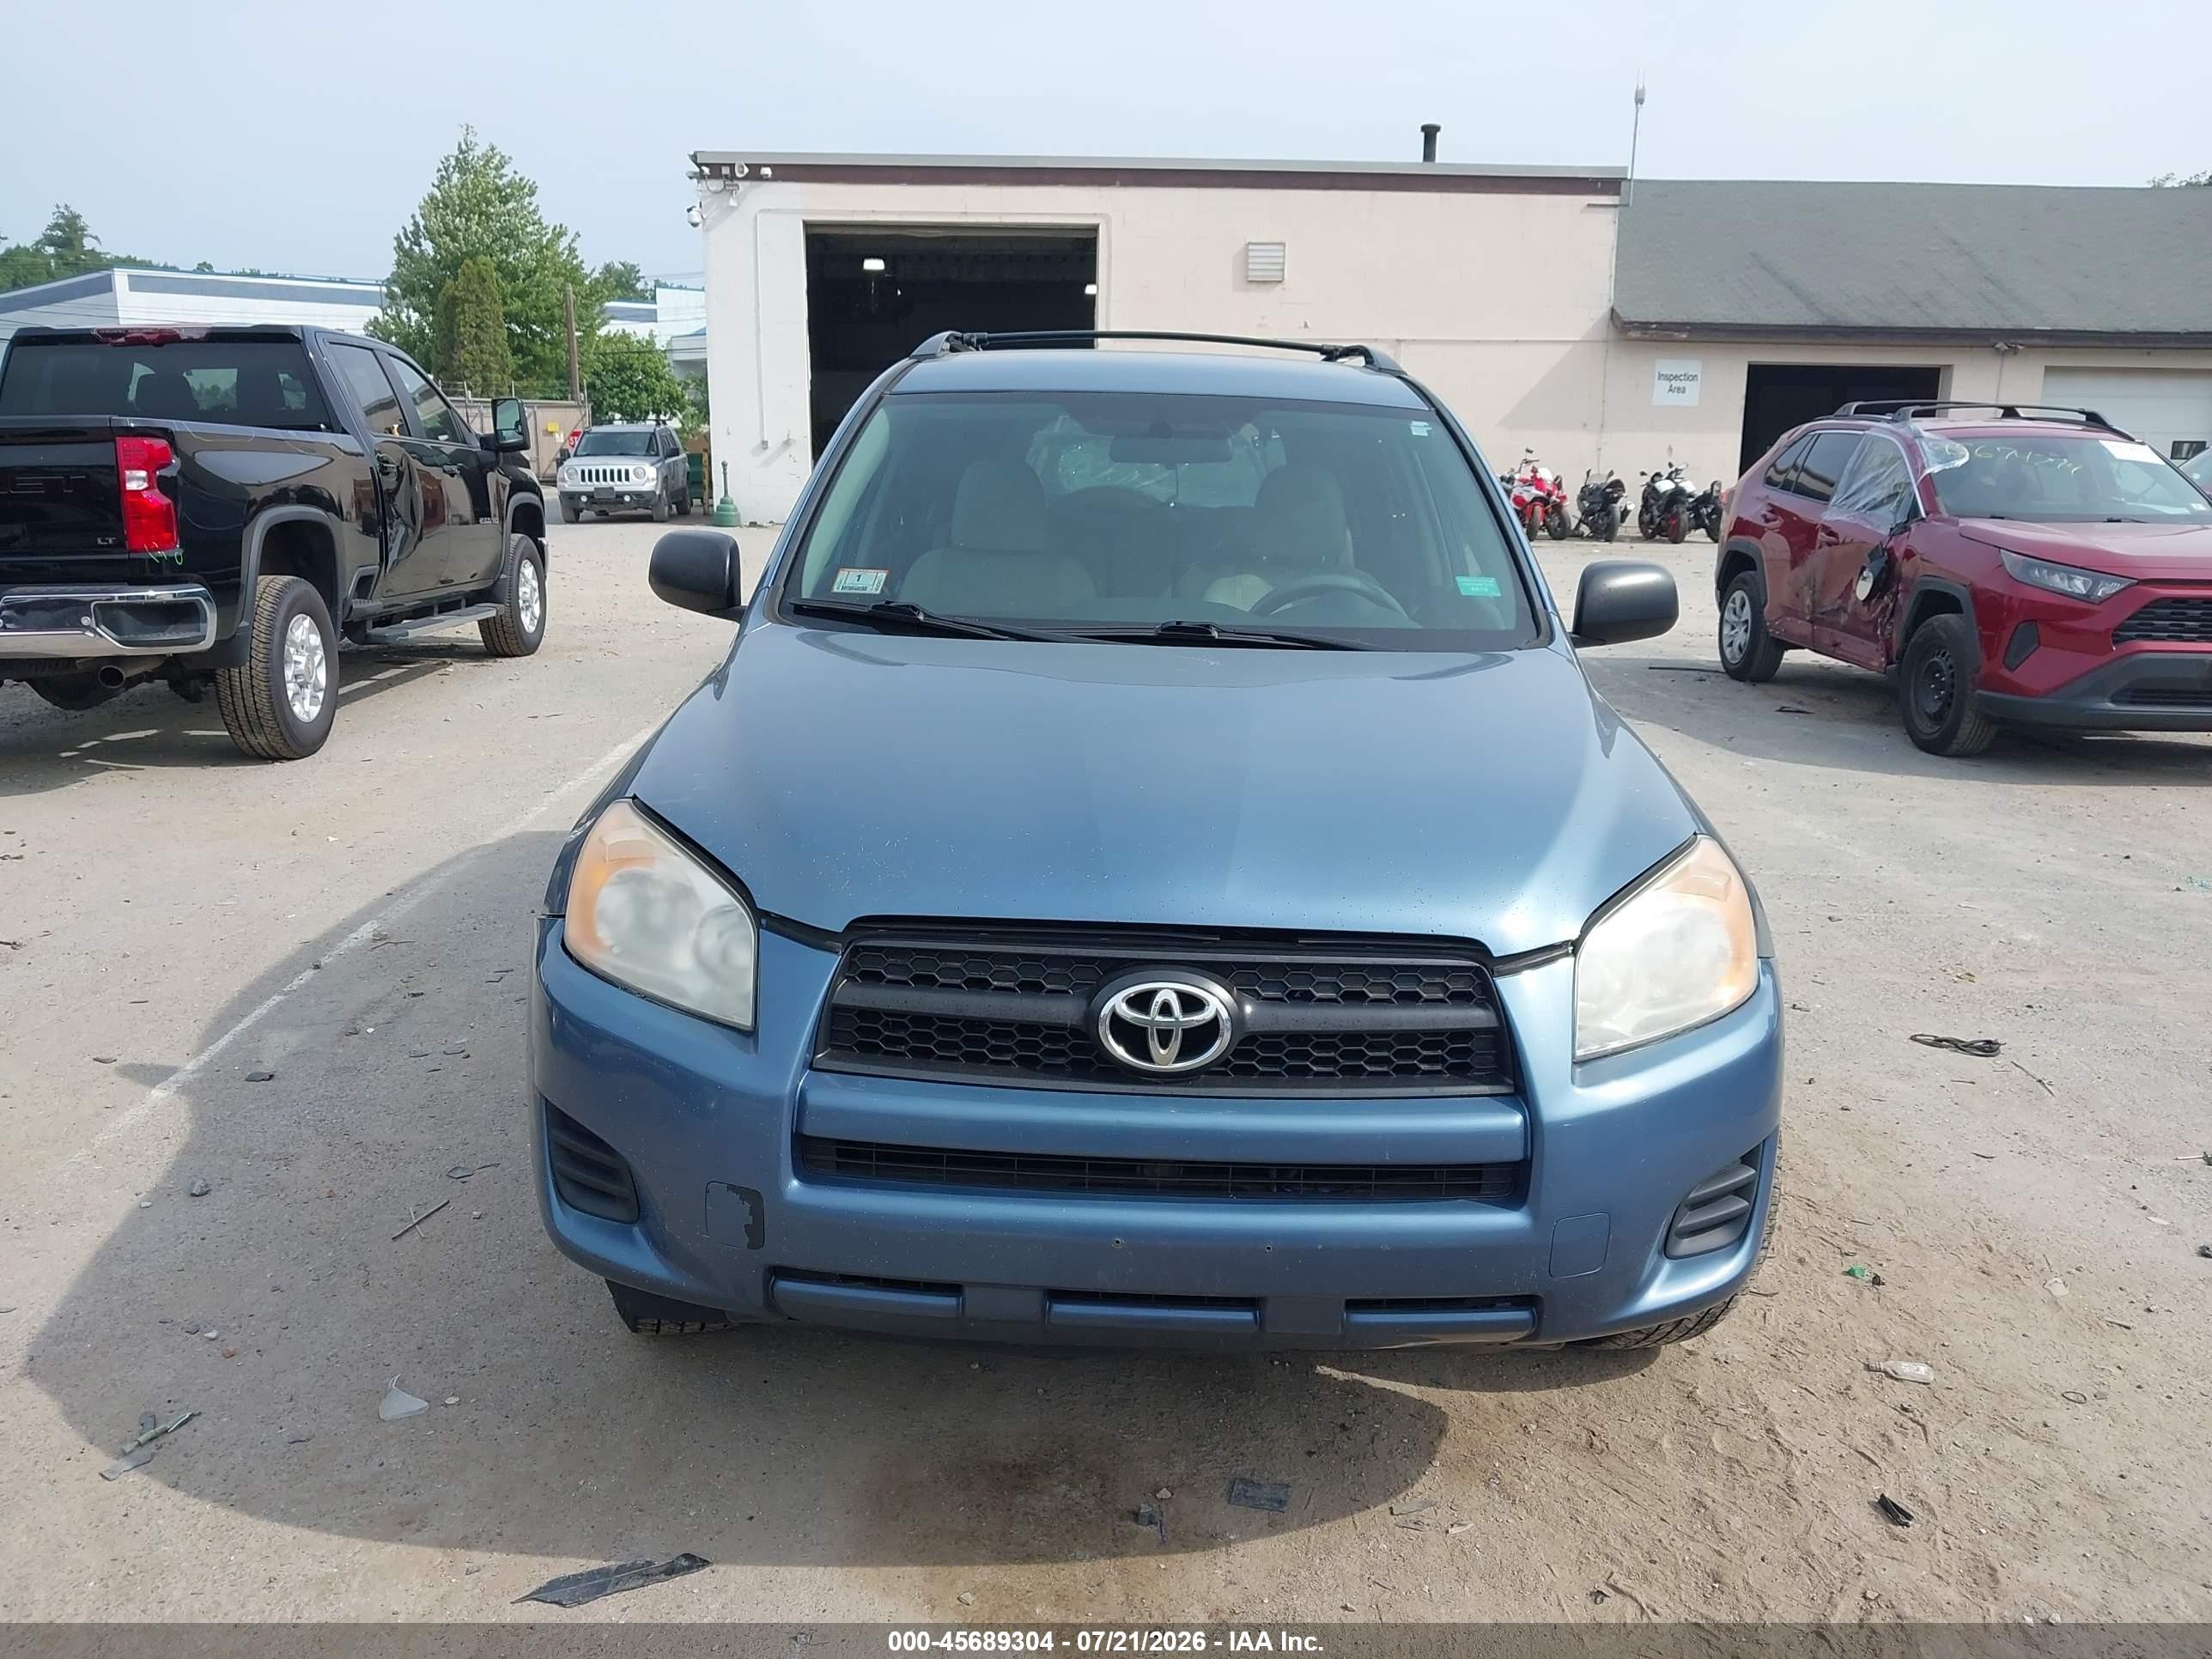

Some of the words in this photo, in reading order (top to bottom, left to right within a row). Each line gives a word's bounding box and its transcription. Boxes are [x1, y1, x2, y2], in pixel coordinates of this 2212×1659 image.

[1657, 371, 1698, 383] Inspection
[1668, 384, 1686, 393] Area
[569, 436, 578, 445] ST
[97, 537, 116, 545] LT
